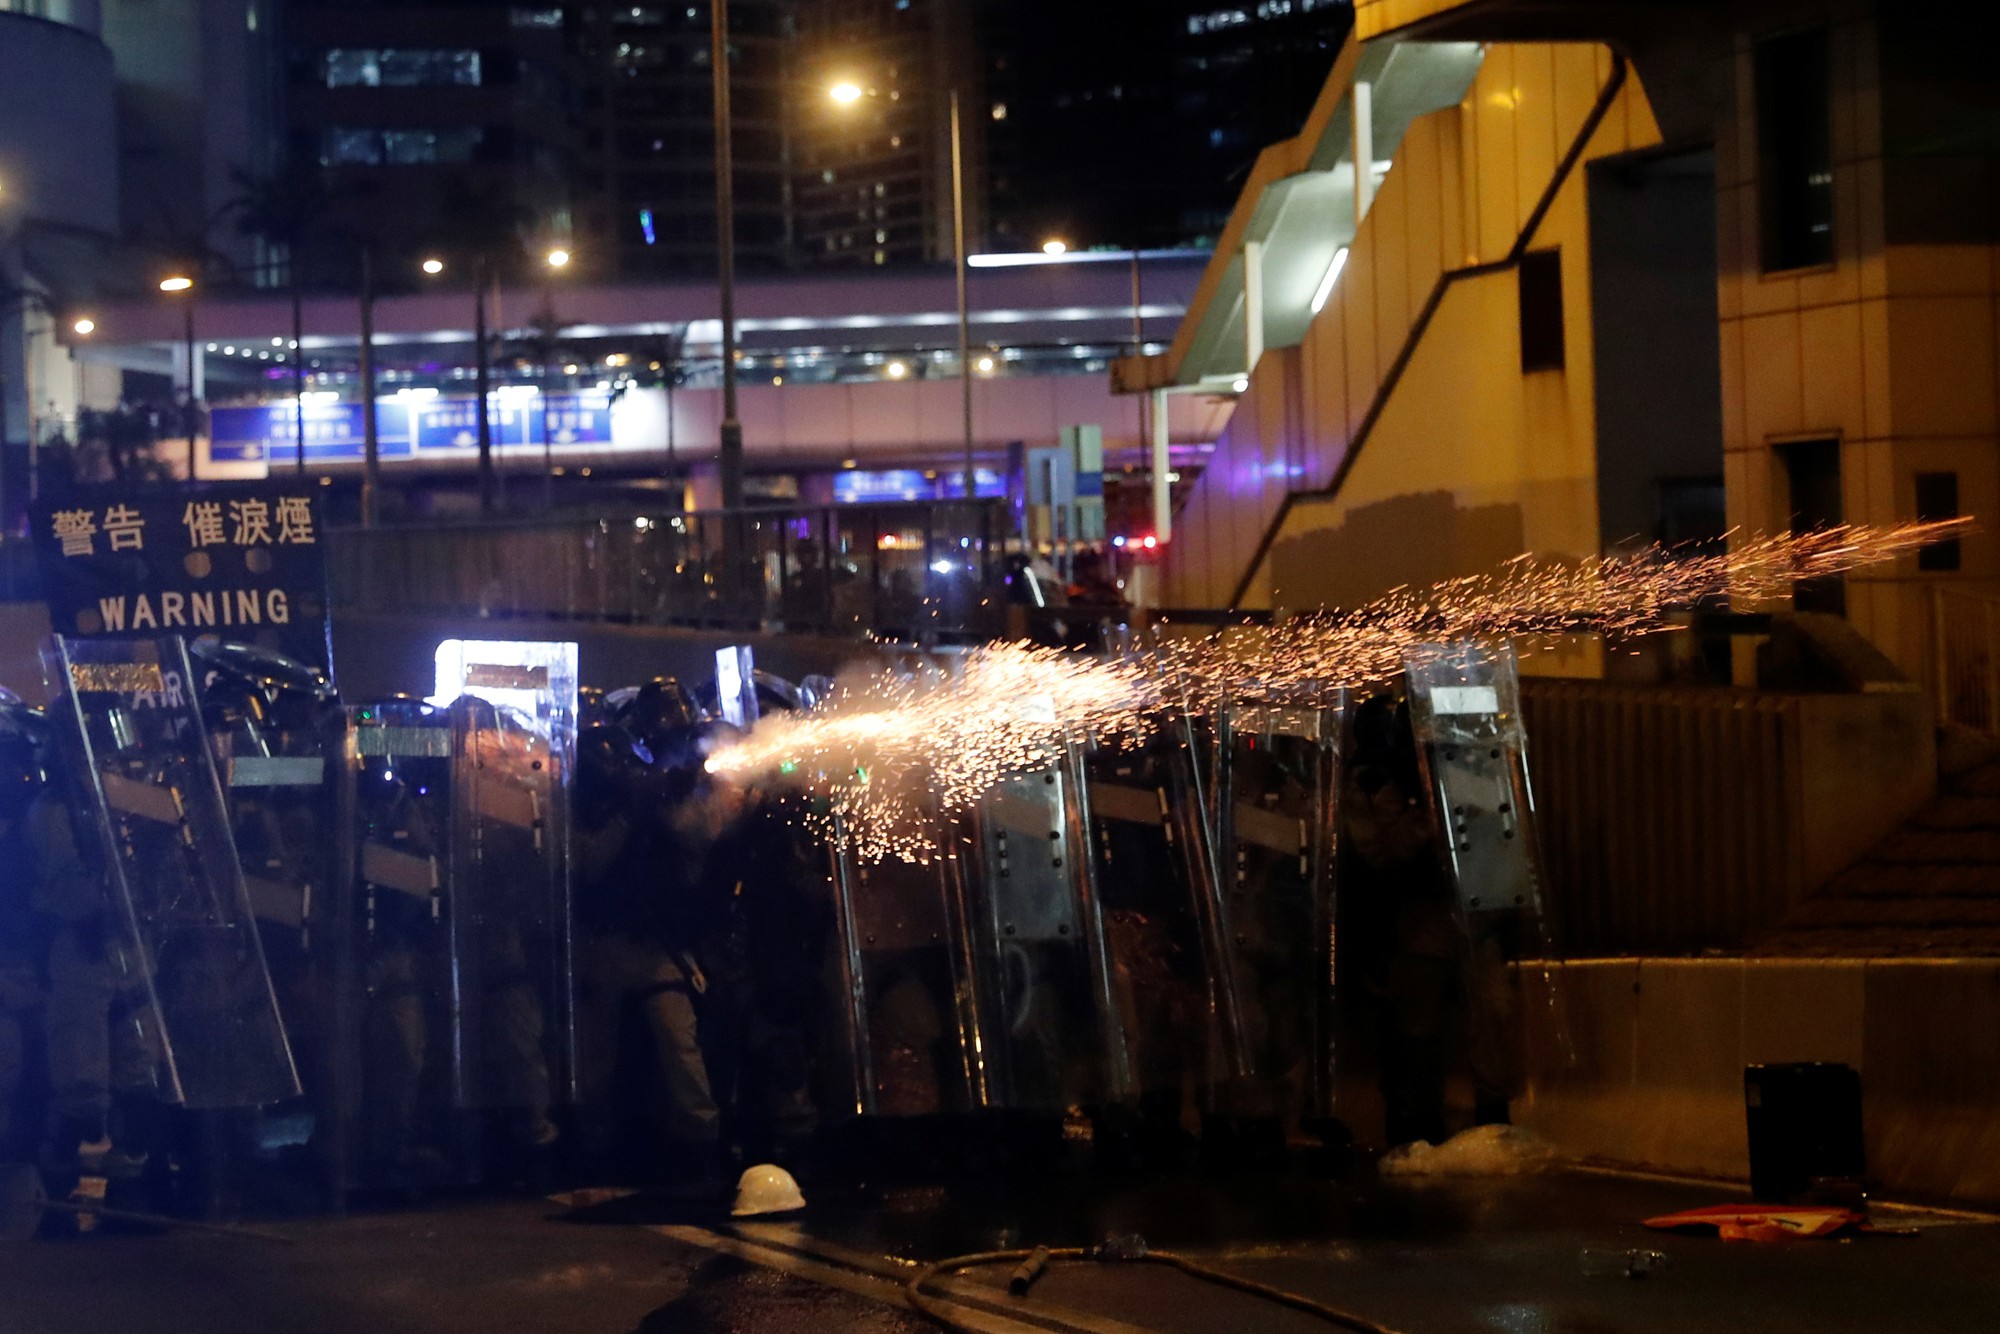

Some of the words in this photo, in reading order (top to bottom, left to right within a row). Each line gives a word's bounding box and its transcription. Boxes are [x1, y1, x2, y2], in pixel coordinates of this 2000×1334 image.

[52, 503, 147, 557] 警告
[183, 496, 316, 548] 催淚煙
[100, 588, 290, 632] WARNING
